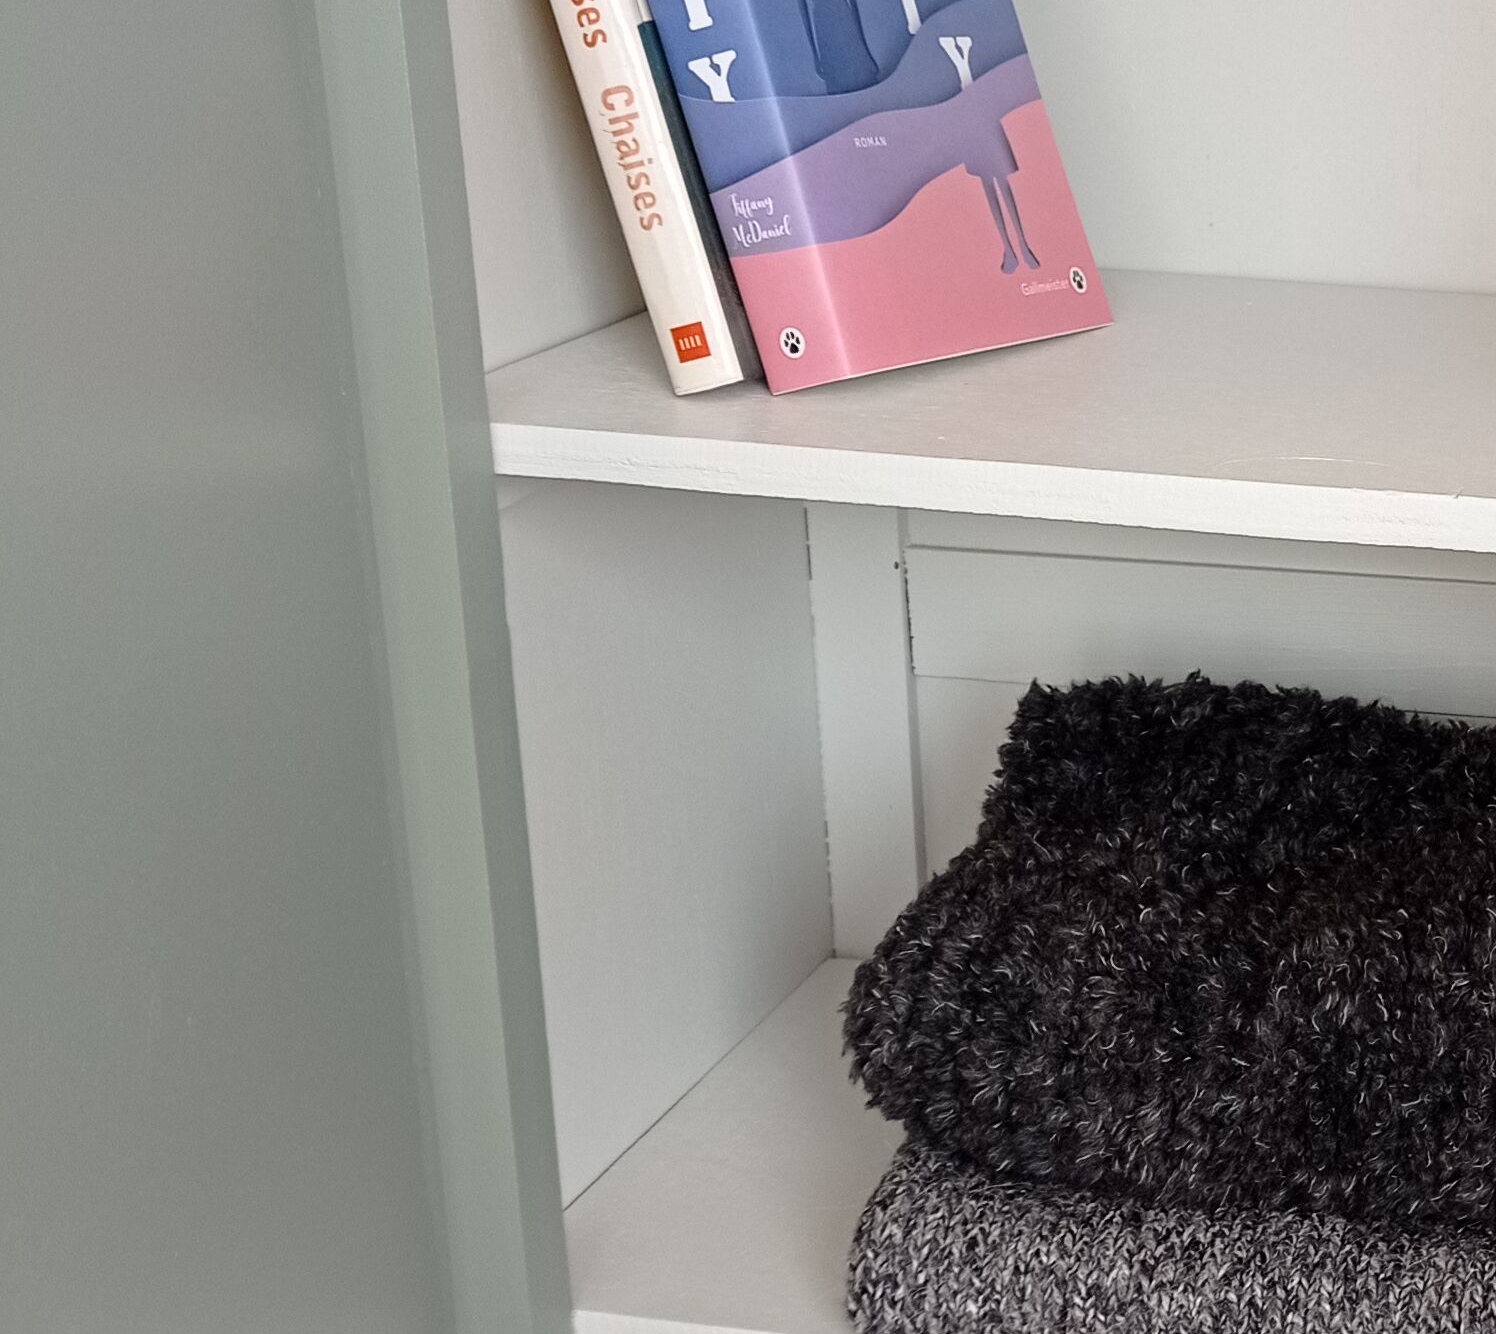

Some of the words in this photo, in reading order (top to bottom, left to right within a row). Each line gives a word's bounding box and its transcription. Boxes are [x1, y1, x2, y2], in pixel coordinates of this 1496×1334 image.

[854, 136, 887, 148] ROMAN
[601, 85, 663, 231] Chaises
[730, 193, 774, 218] Tiffany
[732, 214, 791, 247] McDaniel
